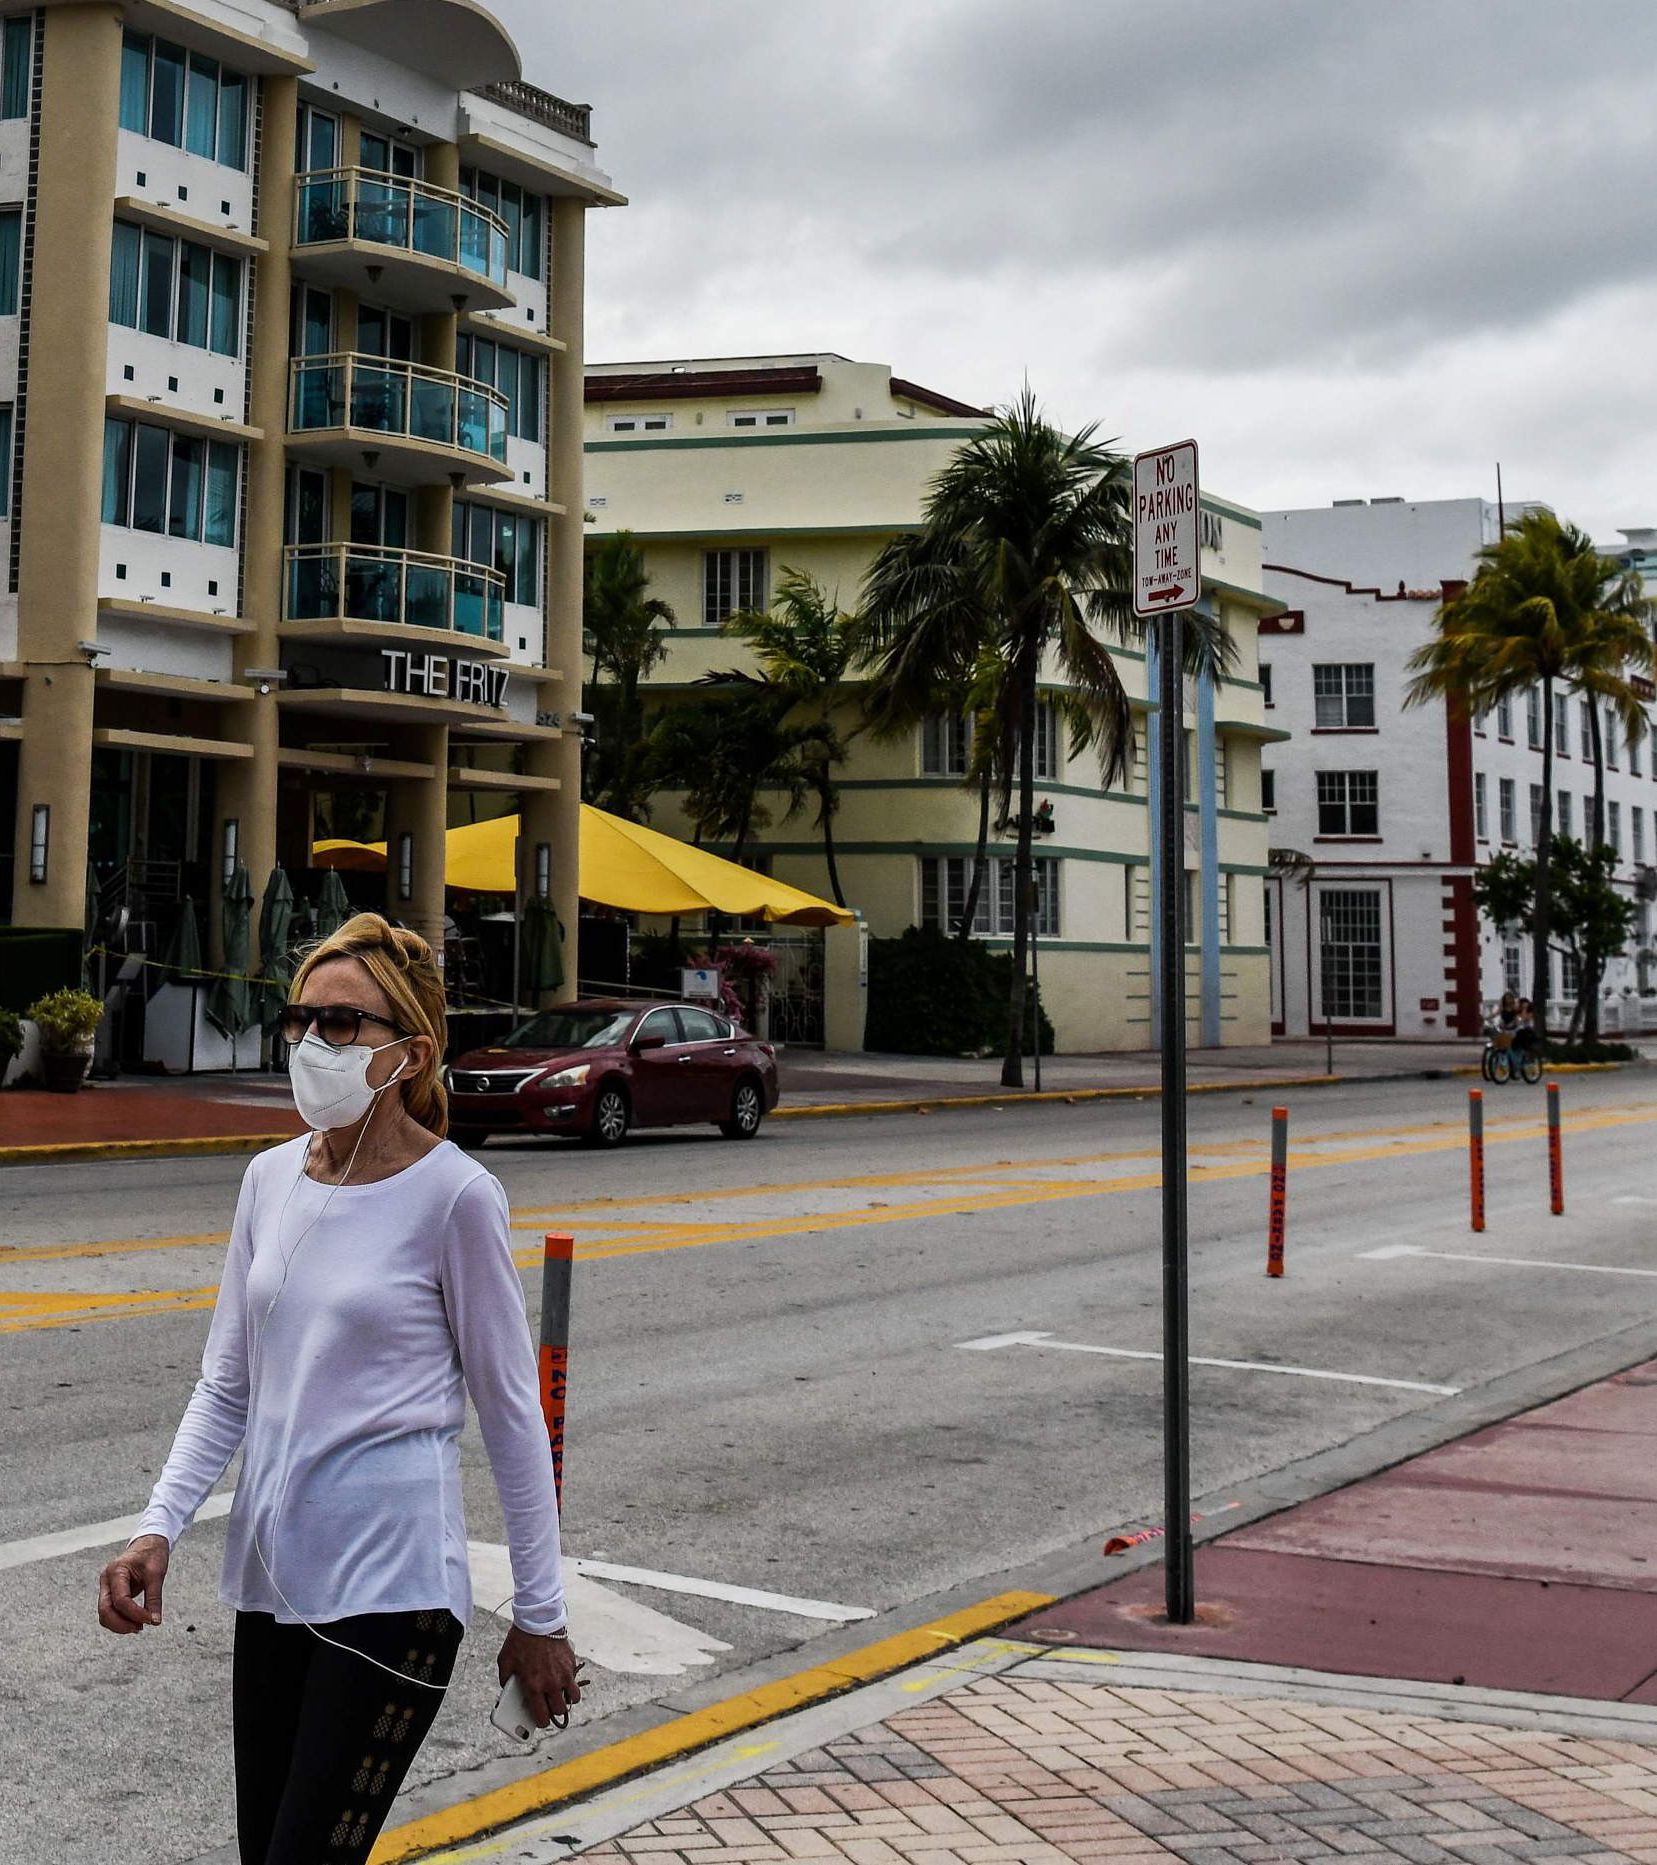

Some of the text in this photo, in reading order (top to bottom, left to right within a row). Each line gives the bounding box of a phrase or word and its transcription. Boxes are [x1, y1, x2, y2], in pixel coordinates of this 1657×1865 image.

[1156, 455, 1175, 486] NO
[1139, 483, 1192, 524] PARKING
[1155, 521, 1178, 545] ANY
[1155, 546, 1178, 569] TIME
[381, 650, 510, 707] THE FRITZ
